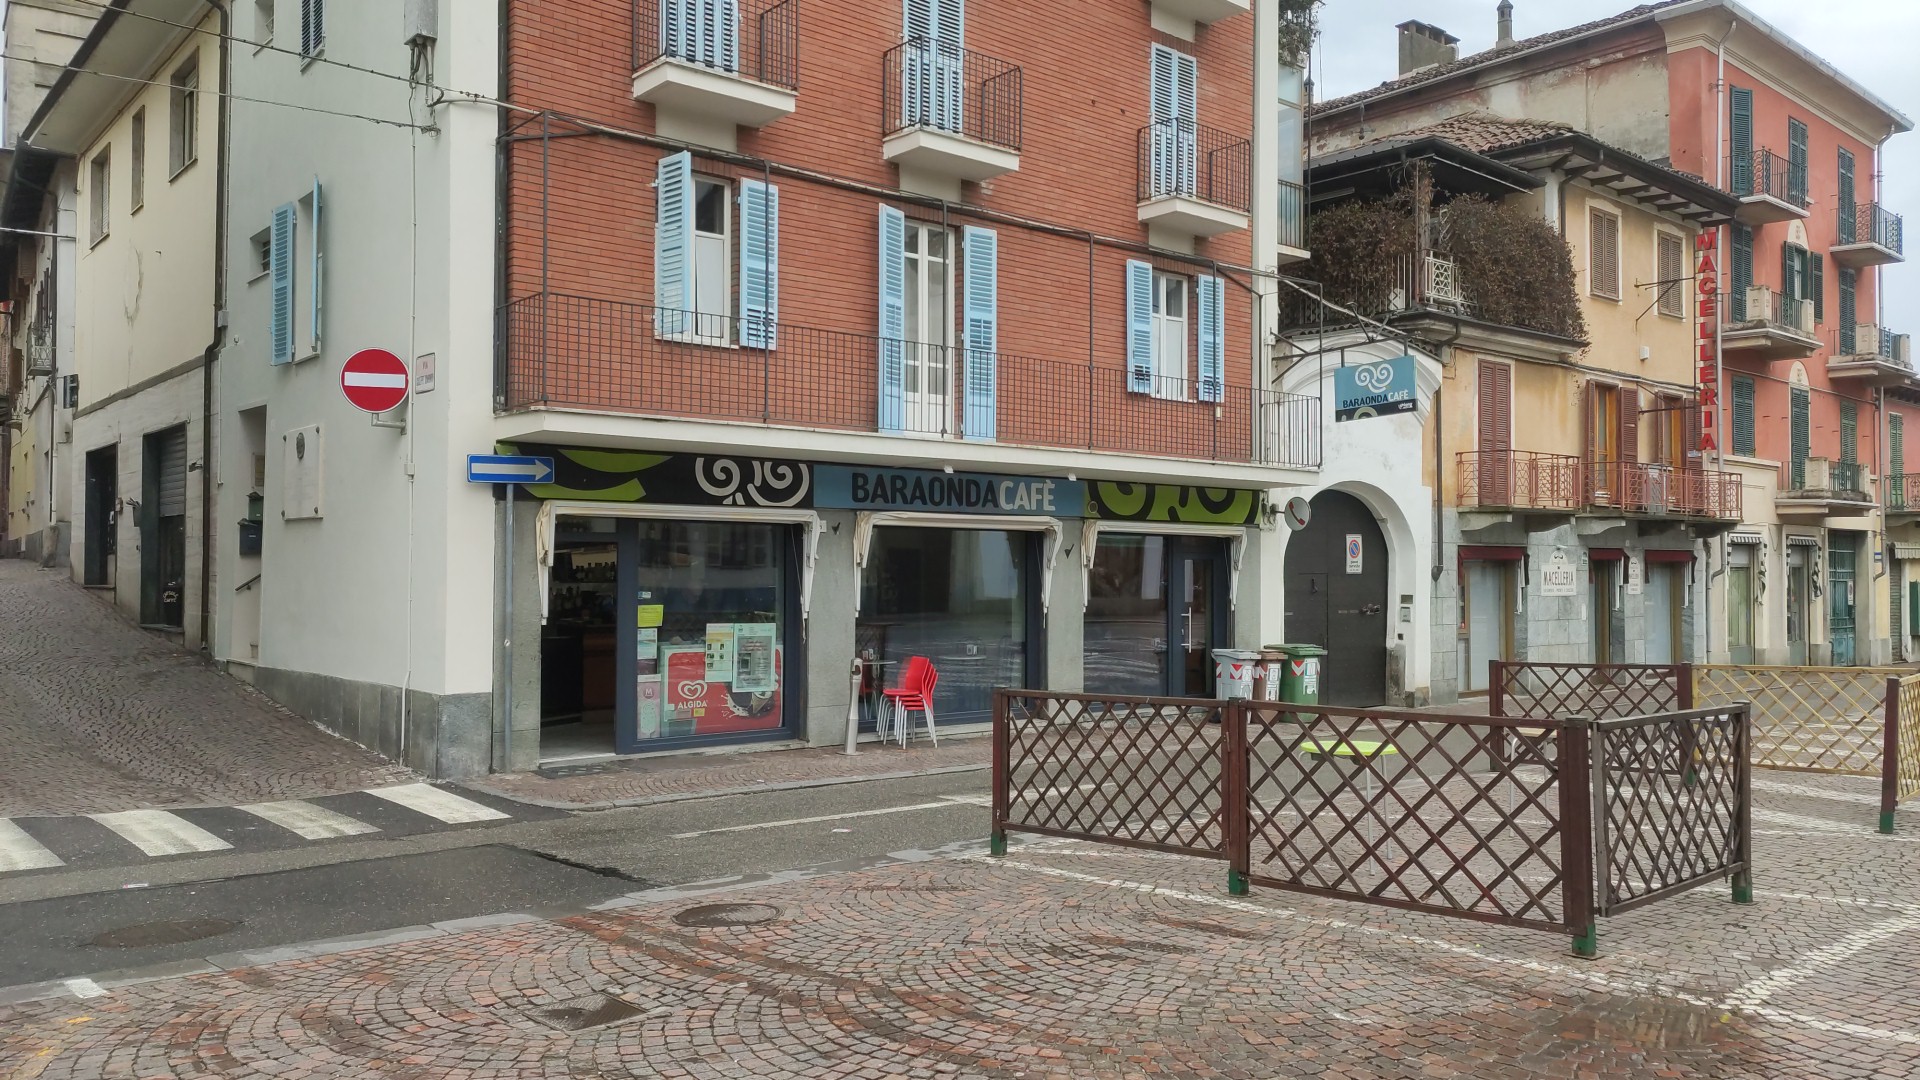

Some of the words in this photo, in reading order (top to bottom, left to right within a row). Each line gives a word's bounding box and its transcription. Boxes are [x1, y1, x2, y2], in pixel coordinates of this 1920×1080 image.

[1696, 232, 1717, 450] MACELLERIA
[852, 472, 1000, 508] BARAONDA
[1543, 571, 1575, 586] MACELLERIA
[677, 700, 708, 710] ALGIDA
